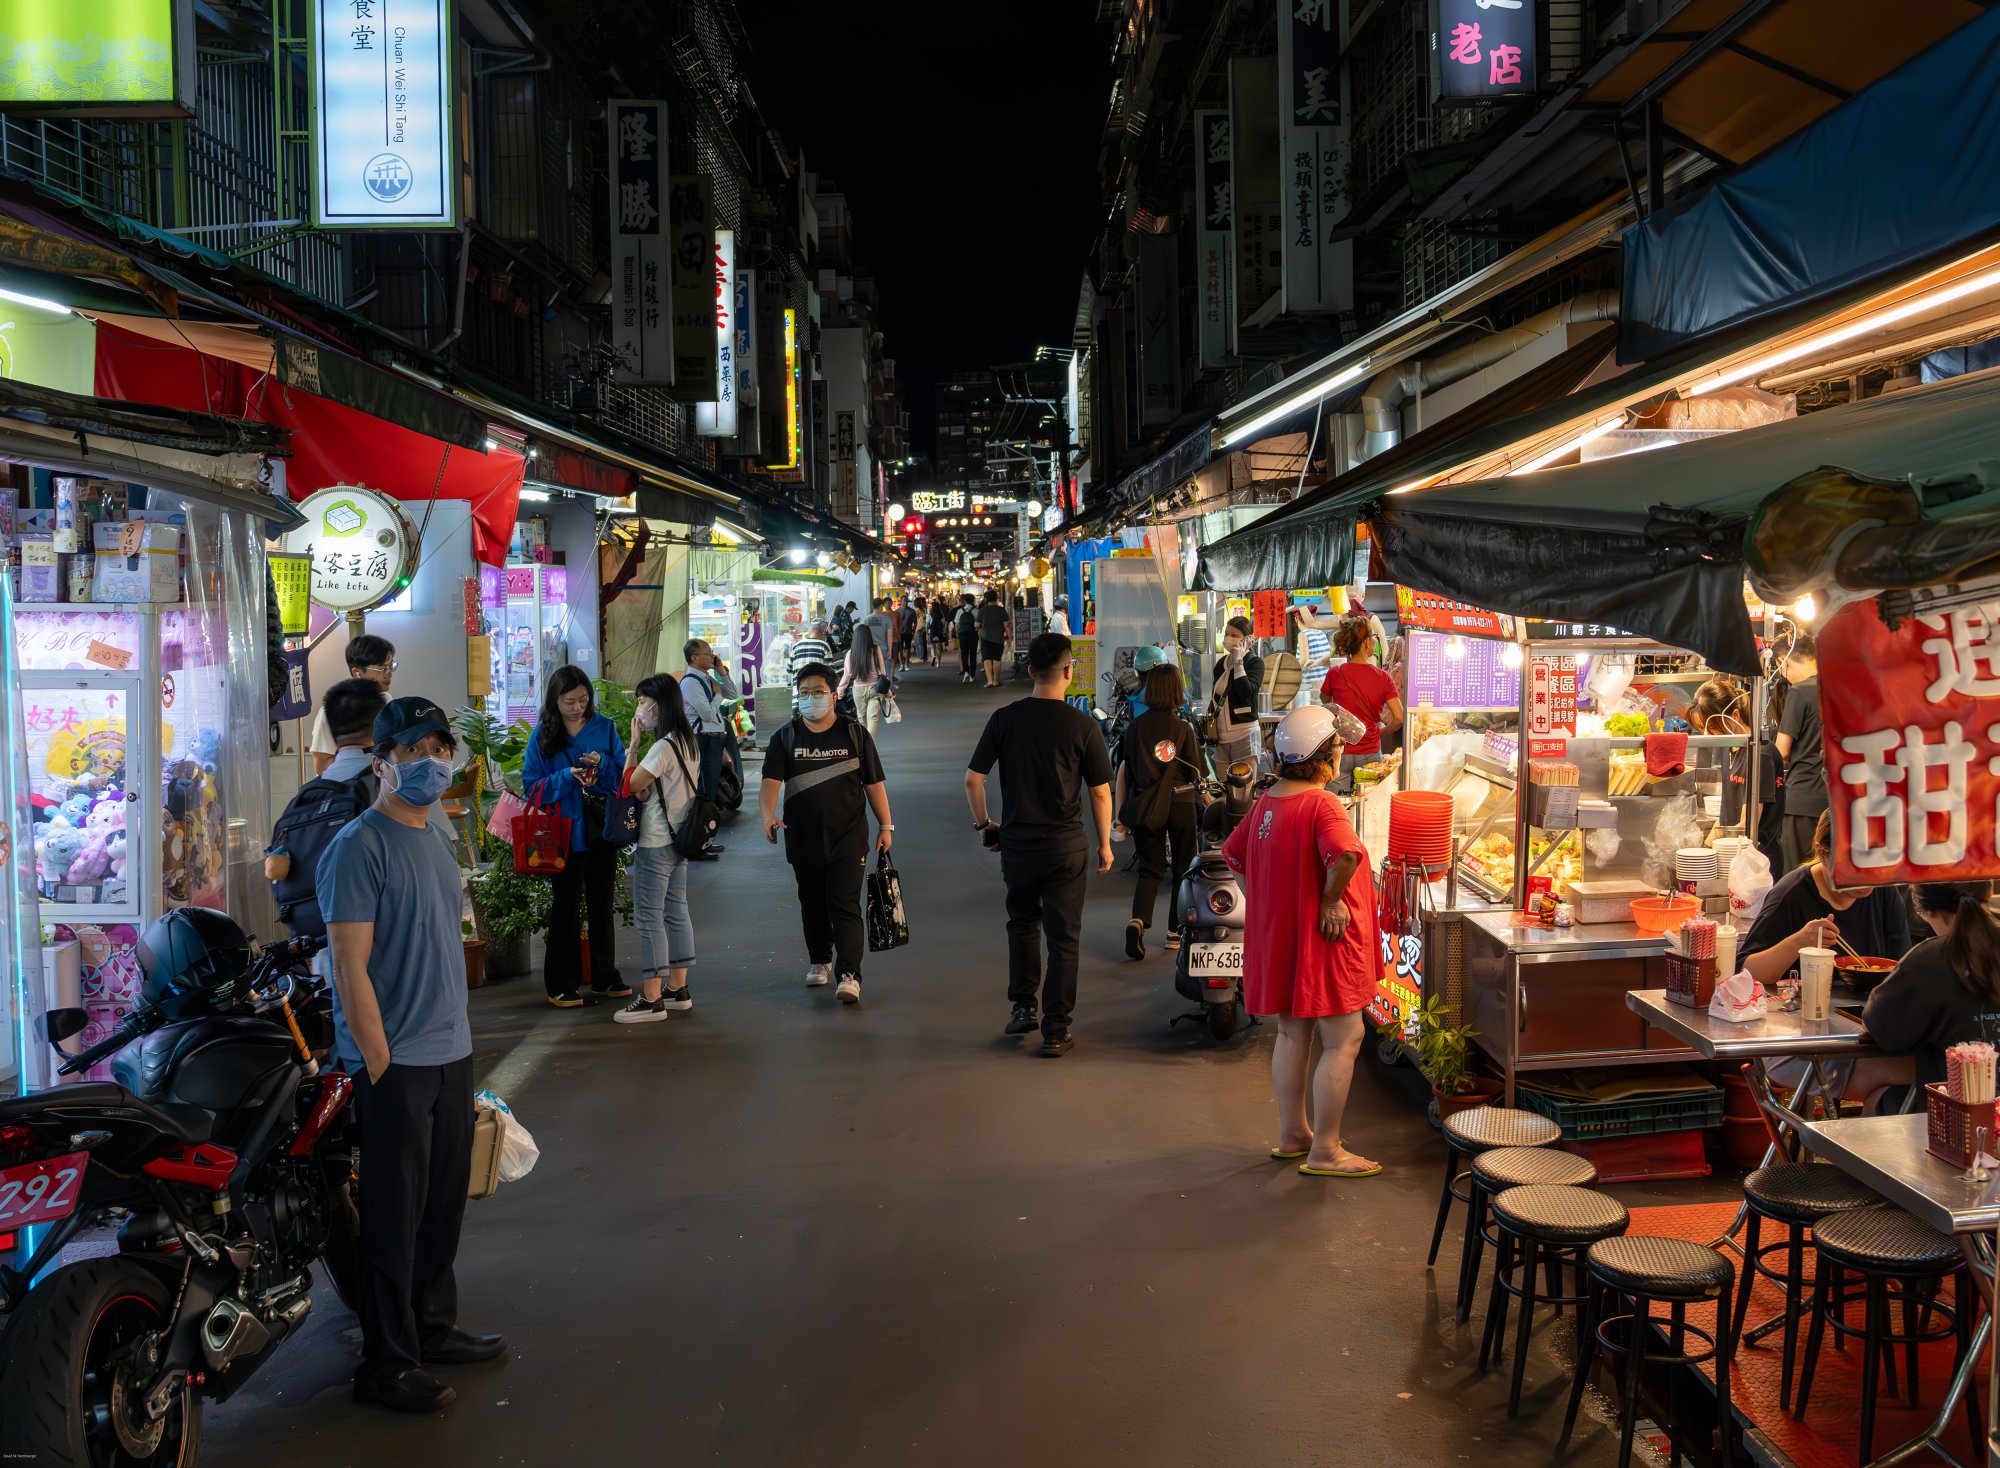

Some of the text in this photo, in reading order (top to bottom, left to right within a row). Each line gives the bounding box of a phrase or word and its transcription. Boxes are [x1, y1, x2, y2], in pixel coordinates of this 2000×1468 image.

[393, 26, 407, 144] Chuan Wei Shi Tang
[1449, 22, 1522, 85] 老店
[619, 111, 659, 231] 隆勝
[1323, 151, 1338, 214] Socks
[721, 346, 732, 402] 西藥房
[317, 580, 340, 590] Like
[1535, 668, 1546, 728] 營業中
[794, 748, 849, 758] FILA MOTOR
[1841, 720, 2000, 869] 甜
